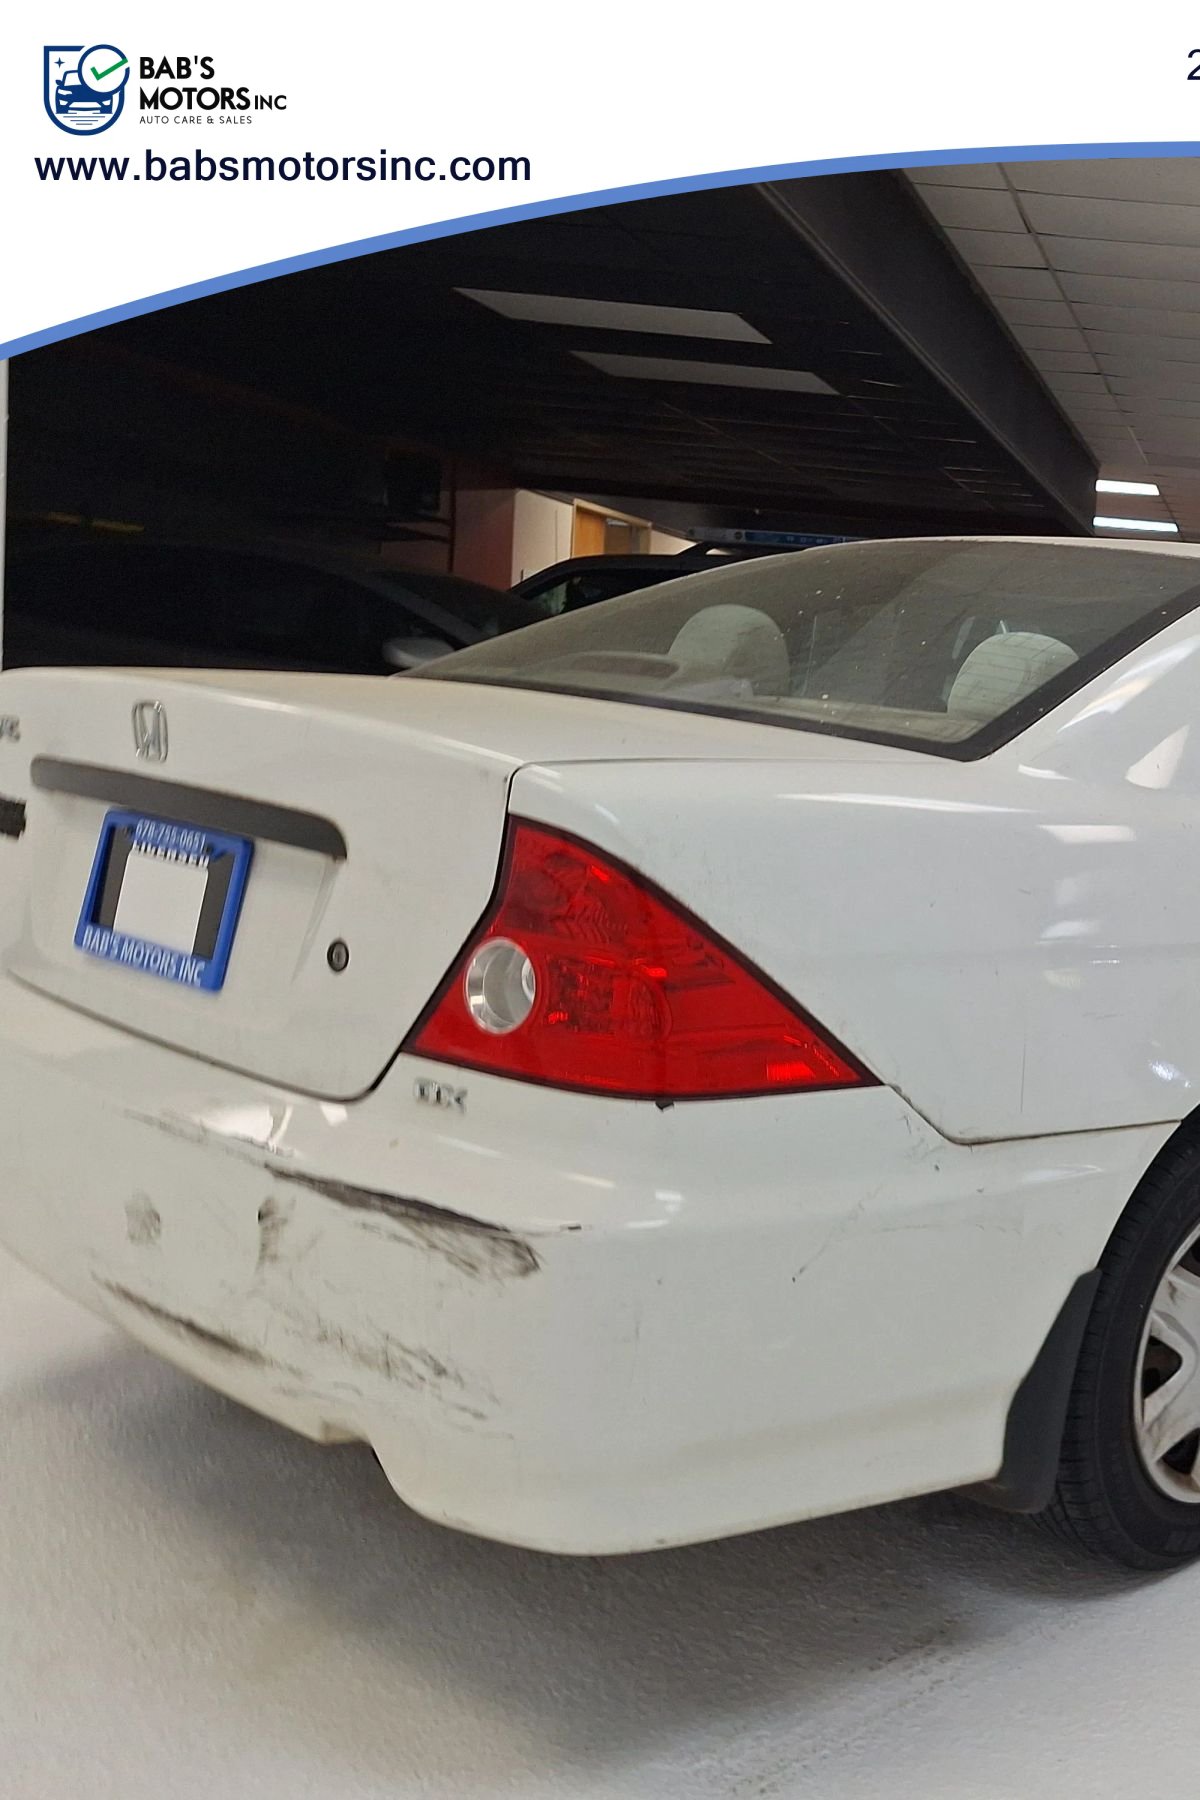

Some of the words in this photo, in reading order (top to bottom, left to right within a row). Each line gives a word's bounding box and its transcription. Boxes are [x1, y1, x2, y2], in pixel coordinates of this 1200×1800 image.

[82, 925, 119, 959] BAB'S
[119, 935, 176, 977] MOTORS
[178, 956, 206, 986] INC
